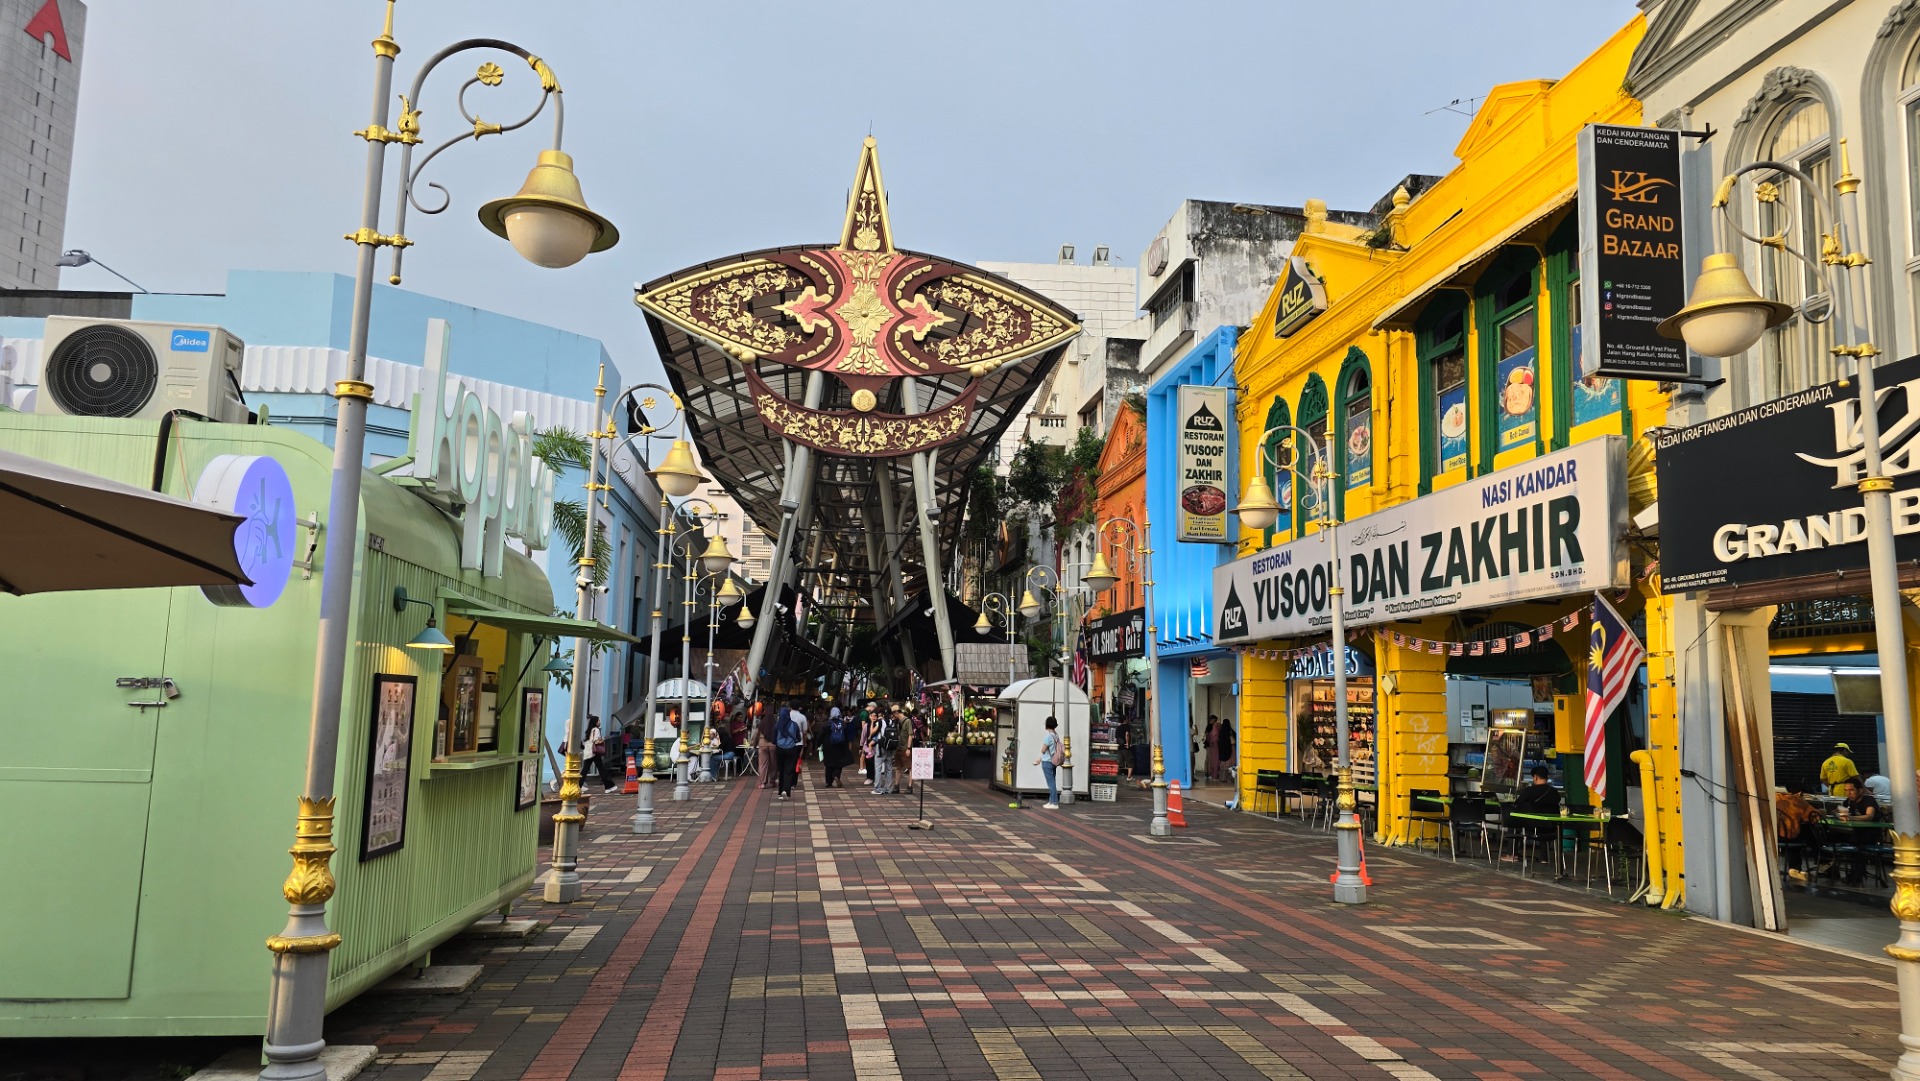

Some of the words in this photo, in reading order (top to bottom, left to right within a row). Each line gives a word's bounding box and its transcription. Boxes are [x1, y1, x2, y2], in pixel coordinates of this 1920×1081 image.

[1597, 128, 1619, 137] KEDAI
[1620, 130, 1670, 141] KRAFTANGAN
[1614, 139, 1669, 149] CENDERAMATA
[1610, 170, 1658, 204] KL
[1606, 208, 1674, 232] GRAND
[1604, 234, 1679, 259] BAZAAR
[174, 335, 206, 346] Midea
[1658, 434, 1681, 449] KEDAI
[1681, 415, 1737, 443] KRAFTANGAN
[1738, 409, 1758, 426] DAN
[1759, 386, 1833, 420] CENDERAMATA
[415, 318, 555, 579] koppiku
[1184, 431, 1224, 442] RESTORAN
[1185, 444, 1224, 456] YUSOOF
[1196, 458, 1212, 467] DAN
[1185, 468, 1222, 481] ZAKHIR
[1482, 480, 1511, 509] NASI
[1515, 459, 1577, 499] KANDAR
[1712, 506, 1868, 563] GRAND
[1253, 559, 1340, 622] YUSOOF
[1351, 541, 1409, 605] DAN
[1420, 495, 1585, 591] ZAKHIR
[1253, 550, 1291, 576] RESTORAN
[1092, 633, 1100, 656] KL
[1101, 626, 1124, 654] SHOE'S
